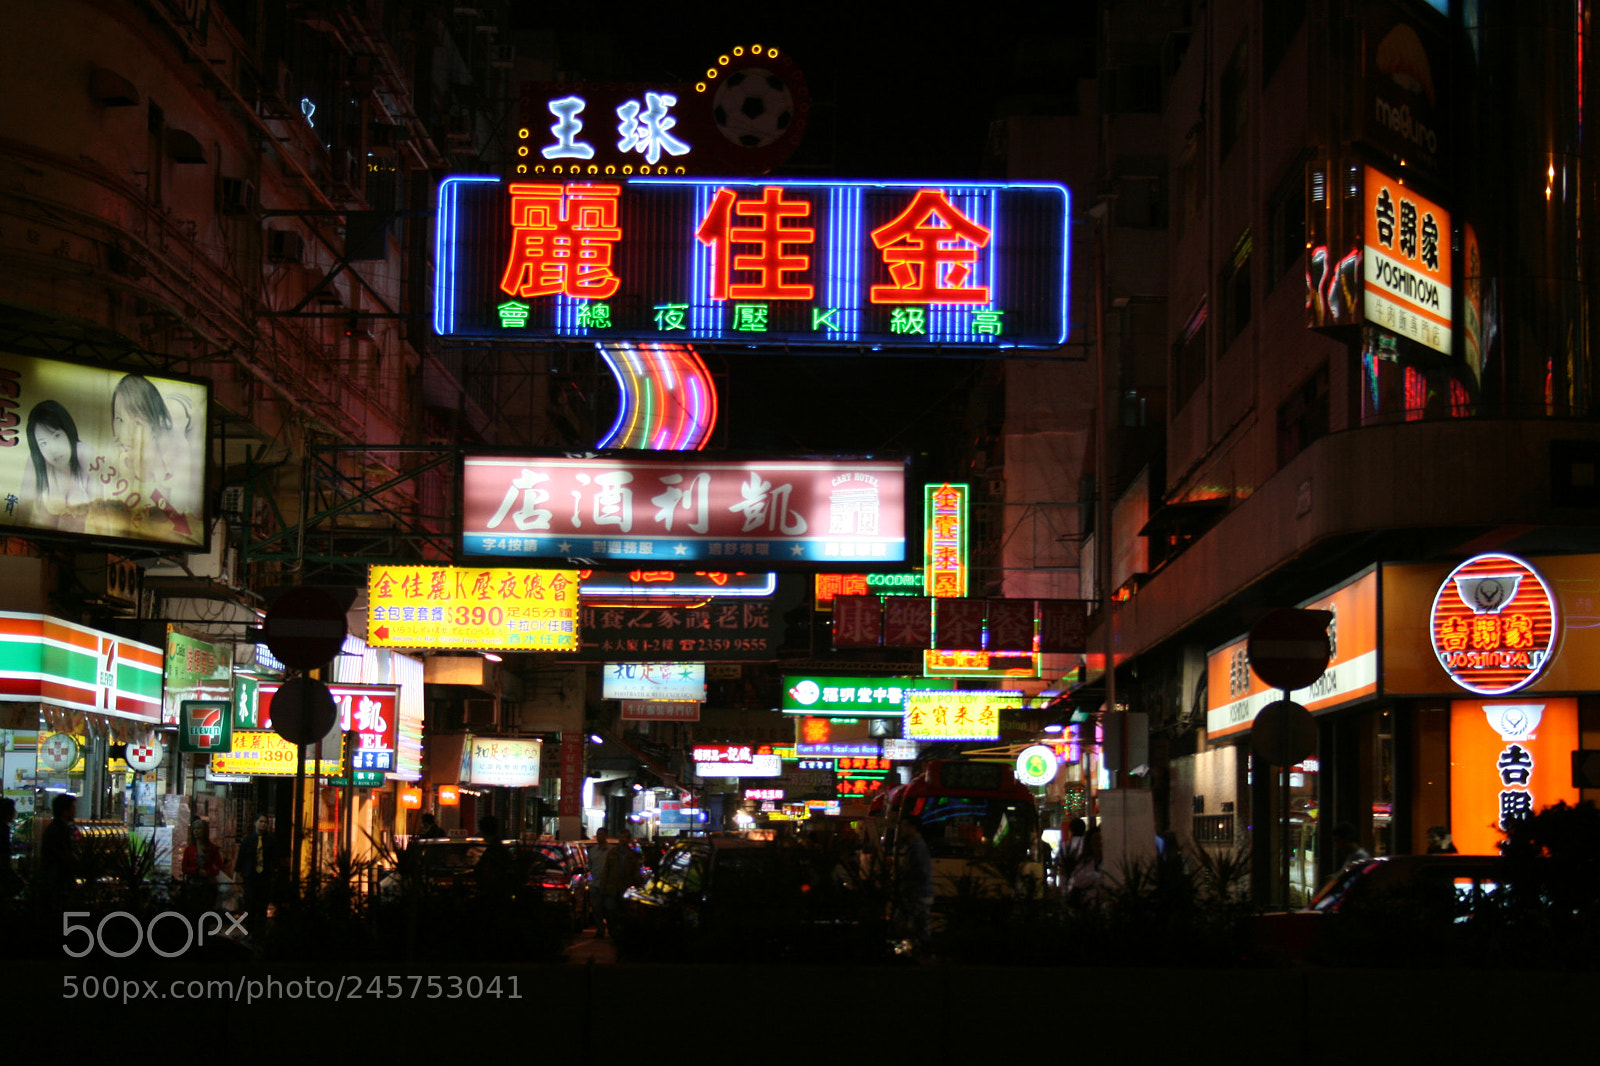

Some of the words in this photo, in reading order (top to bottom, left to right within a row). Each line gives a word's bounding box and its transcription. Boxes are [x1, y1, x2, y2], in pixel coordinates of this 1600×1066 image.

[1375, 256, 1440, 311] YOSHINOYA
[831, 472, 853, 487] CARY
[854, 472, 879, 488] HOTEL
[374, 570, 574, 603] 金佳麗K壓夜總會
[866, 573, 924, 586] GOODRIC
[838, 600, 1087, 649] 康樂茶餐廳
[698, 639, 731, 652] 2359
[734, 640, 768, 652] 9555
[1448, 649, 1531, 668] YOSHINOYA
[189, 726, 220, 736] ELEVEN
